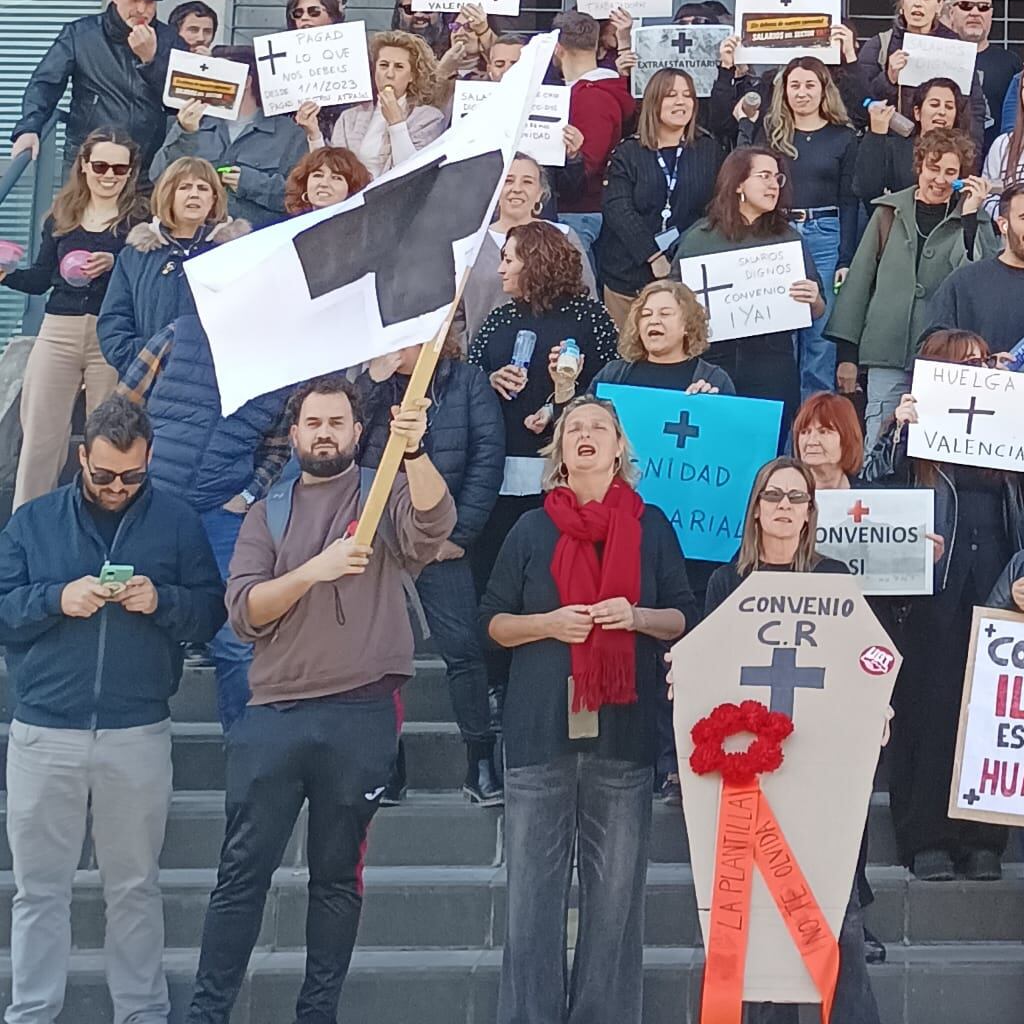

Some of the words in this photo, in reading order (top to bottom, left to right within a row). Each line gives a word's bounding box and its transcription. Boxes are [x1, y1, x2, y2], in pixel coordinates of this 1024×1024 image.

[296, 30, 343, 44] PAGAD
[296, 53, 311, 63] LO
[323, 48, 350, 59] QUE
[282, 71, 302, 82] NOS
[309, 64, 347, 76] DEBEIS
[298, 80, 357, 93] 1/1/2023
[745, 264, 791, 280] DIGNOS
[724, 286, 786, 304] CONVENIO
[933, 368, 1015, 392] HUELGA
[924, 431, 1024, 461] VALENCIA
[815, 527, 918, 543] ONVENIOS
[849, 559, 864, 575] SI
[739, 596, 855, 617] CONVENIO
[757, 621, 818, 647] C.R
[997, 723, 1024, 750] ES
